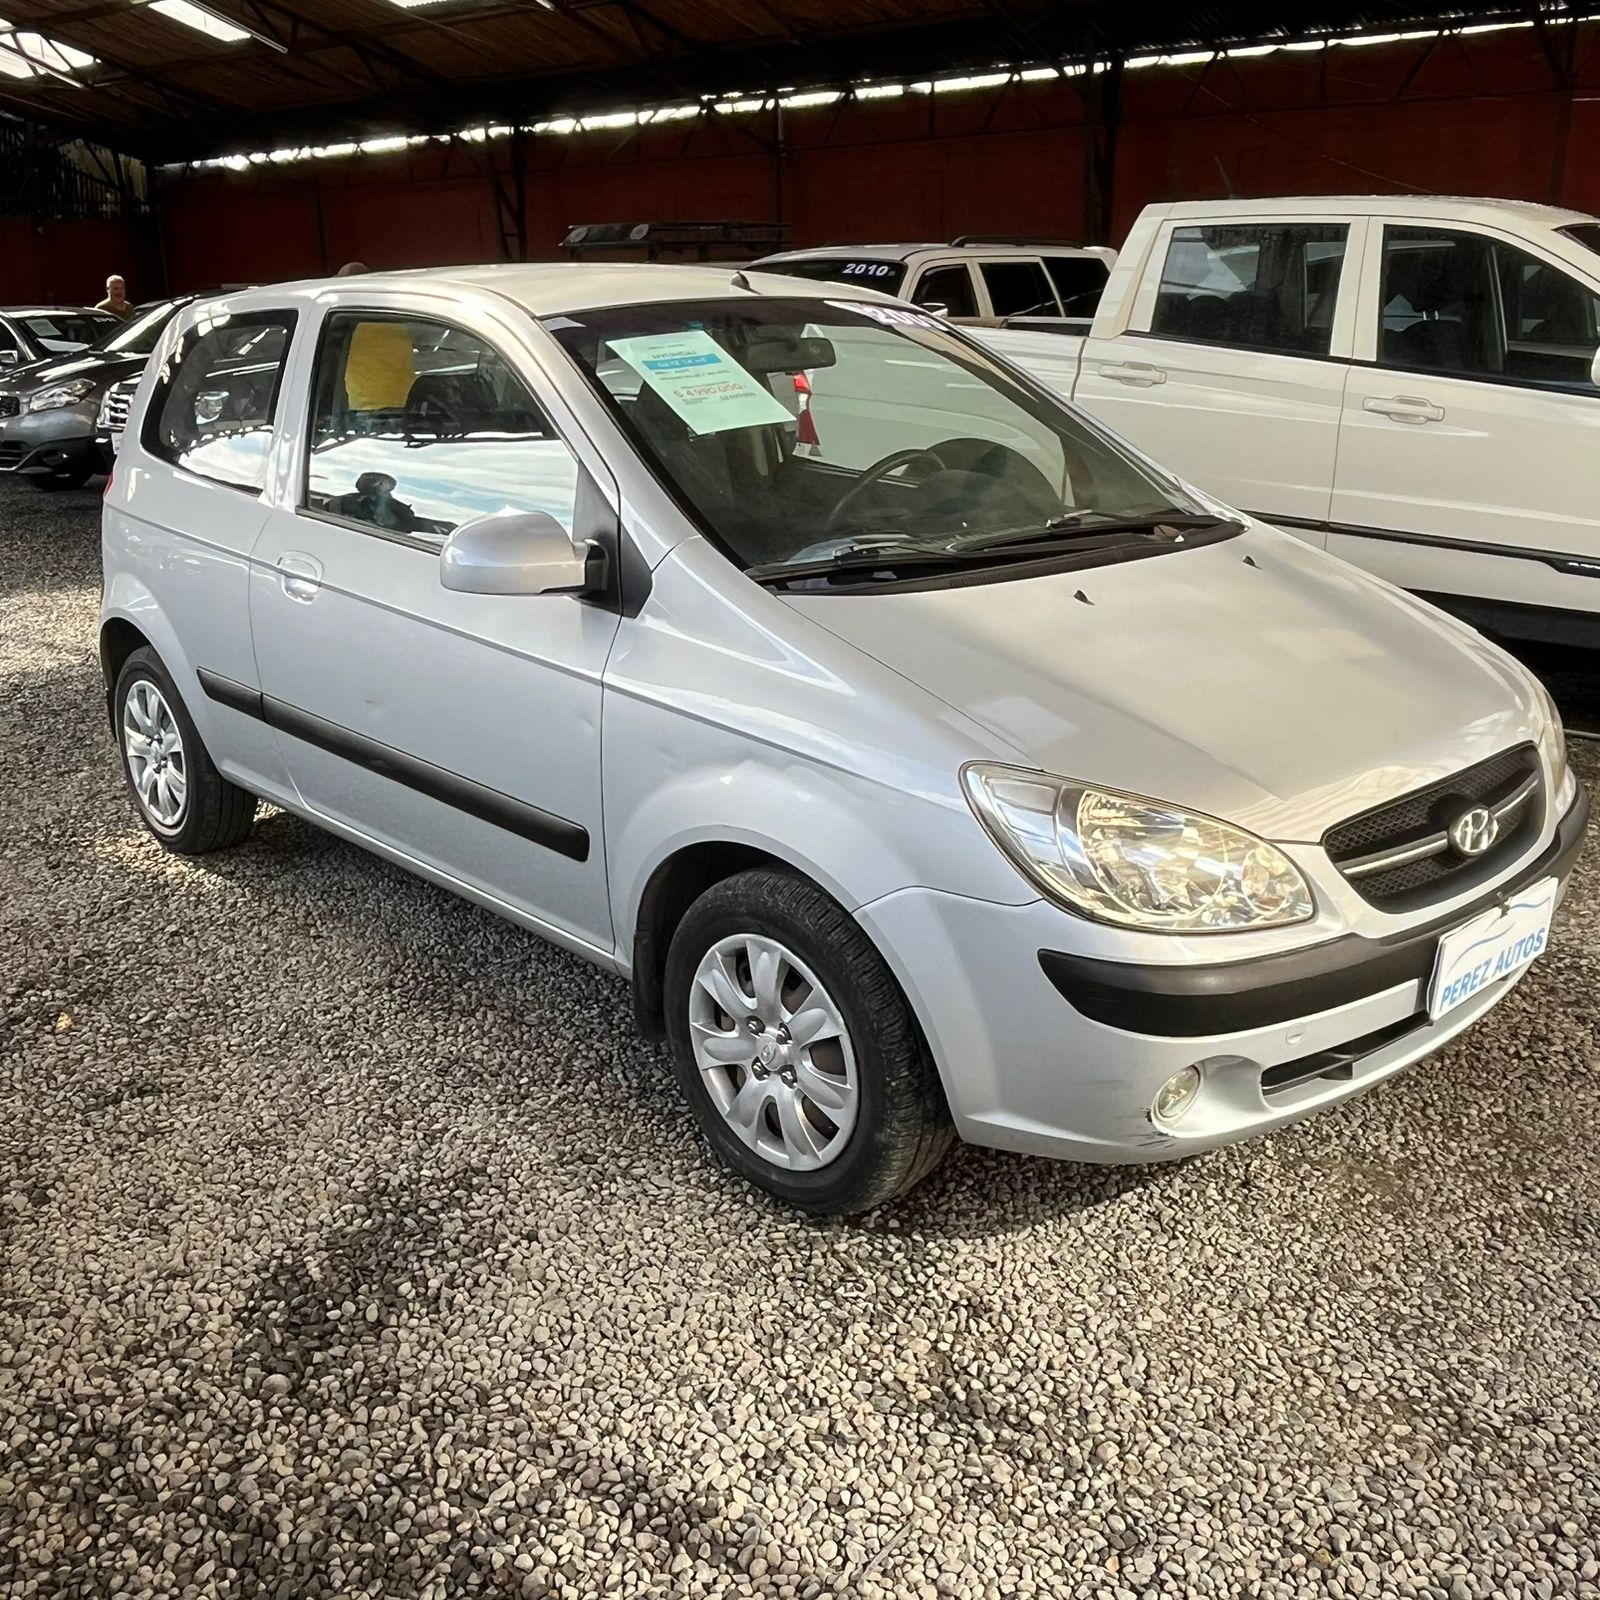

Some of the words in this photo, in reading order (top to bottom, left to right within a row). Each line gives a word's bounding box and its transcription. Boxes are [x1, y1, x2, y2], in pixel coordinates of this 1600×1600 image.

[843, 263, 889, 277] 2010
[1439, 956, 1493, 1012] PEREZ
[1492, 927, 1546, 975] AUTOS
